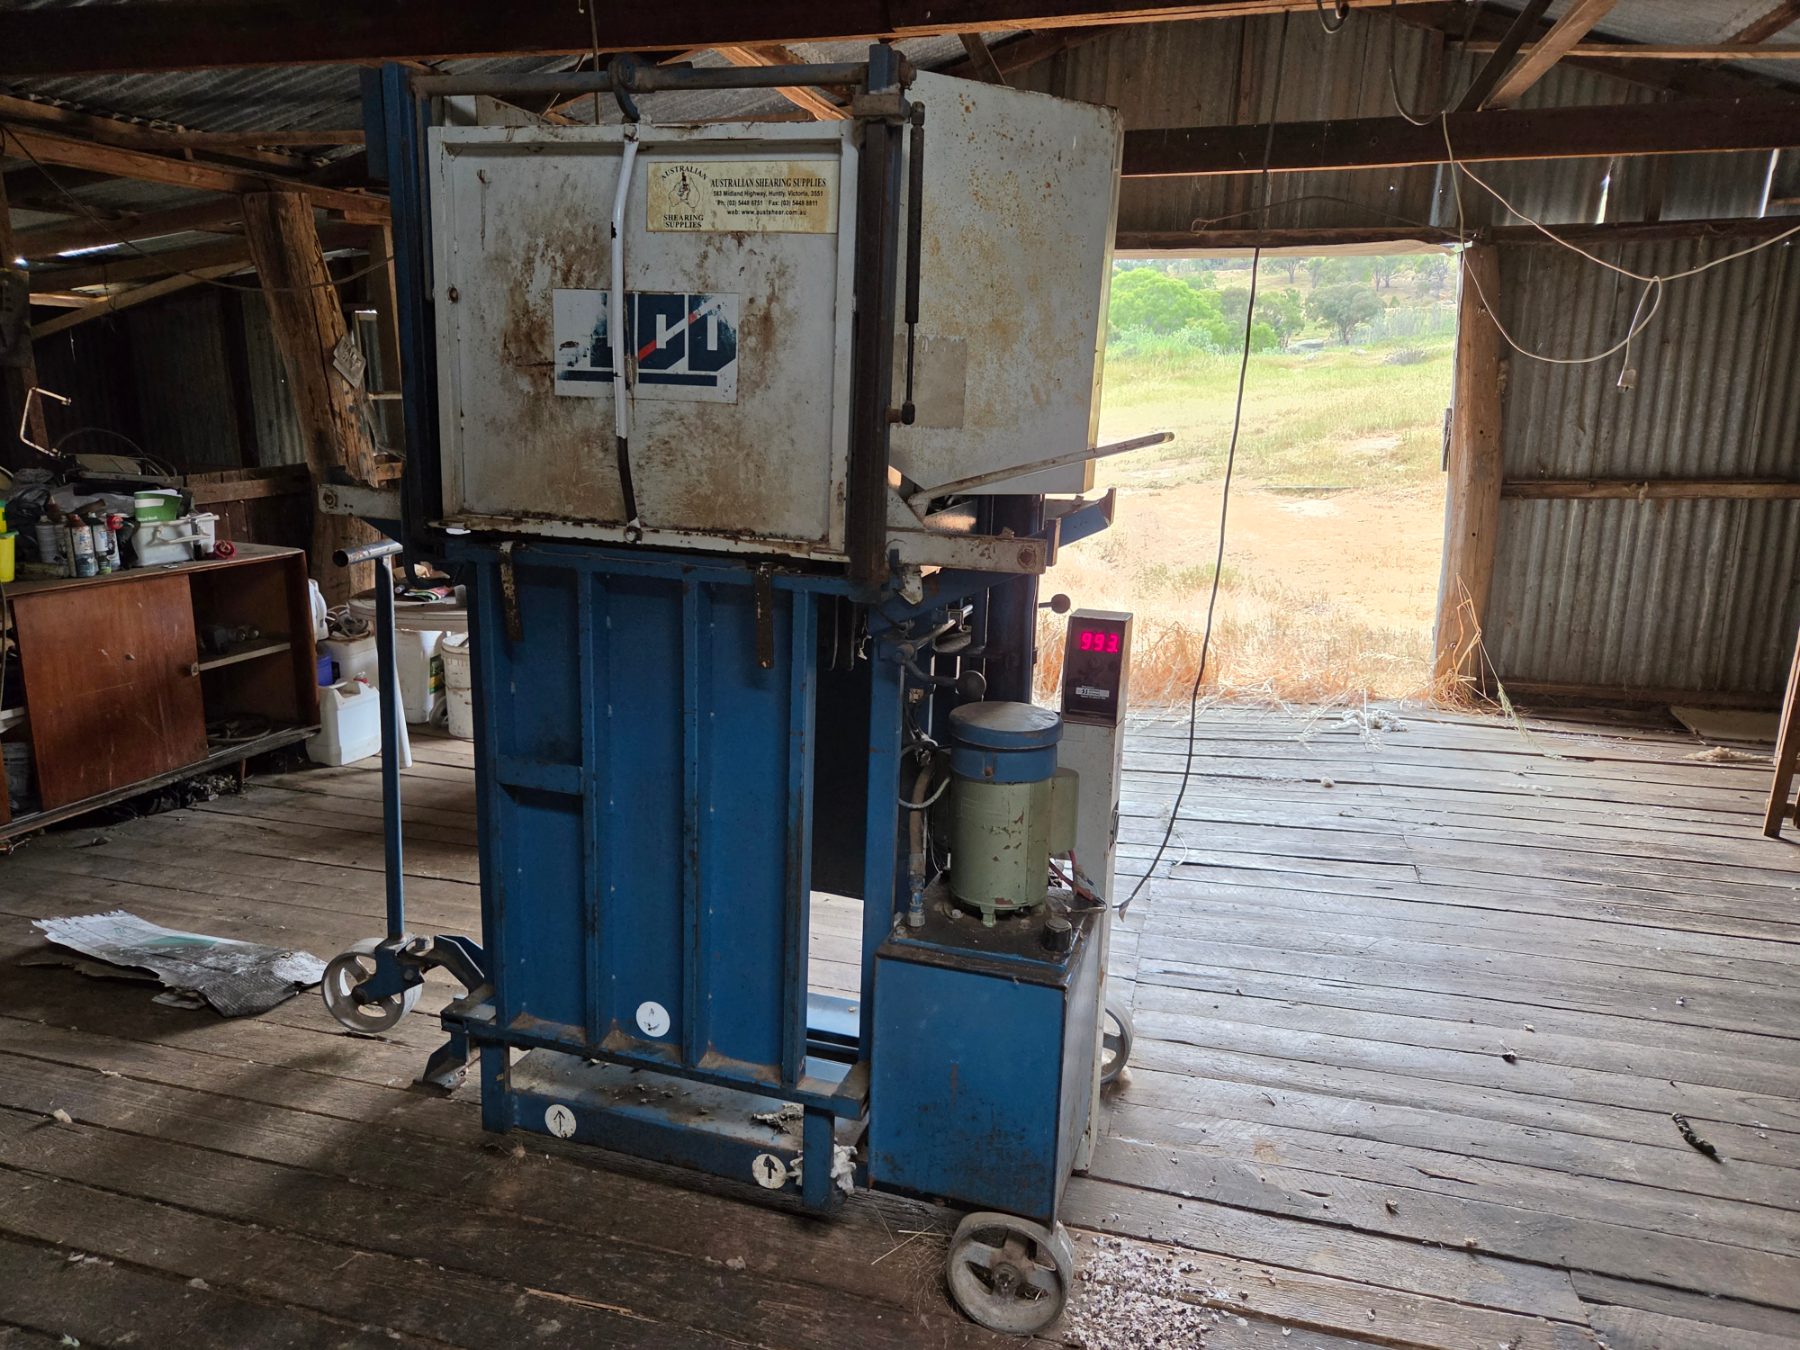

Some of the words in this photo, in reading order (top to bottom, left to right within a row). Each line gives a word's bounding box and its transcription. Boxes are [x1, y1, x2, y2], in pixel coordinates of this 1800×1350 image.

[661, 165, 708, 181] AUSTRALIAN
[710, 178, 754, 187] AUSTRALIAN
[756, 177, 791, 187] SHEARING
[793, 177, 827, 187] SUPPLIES
